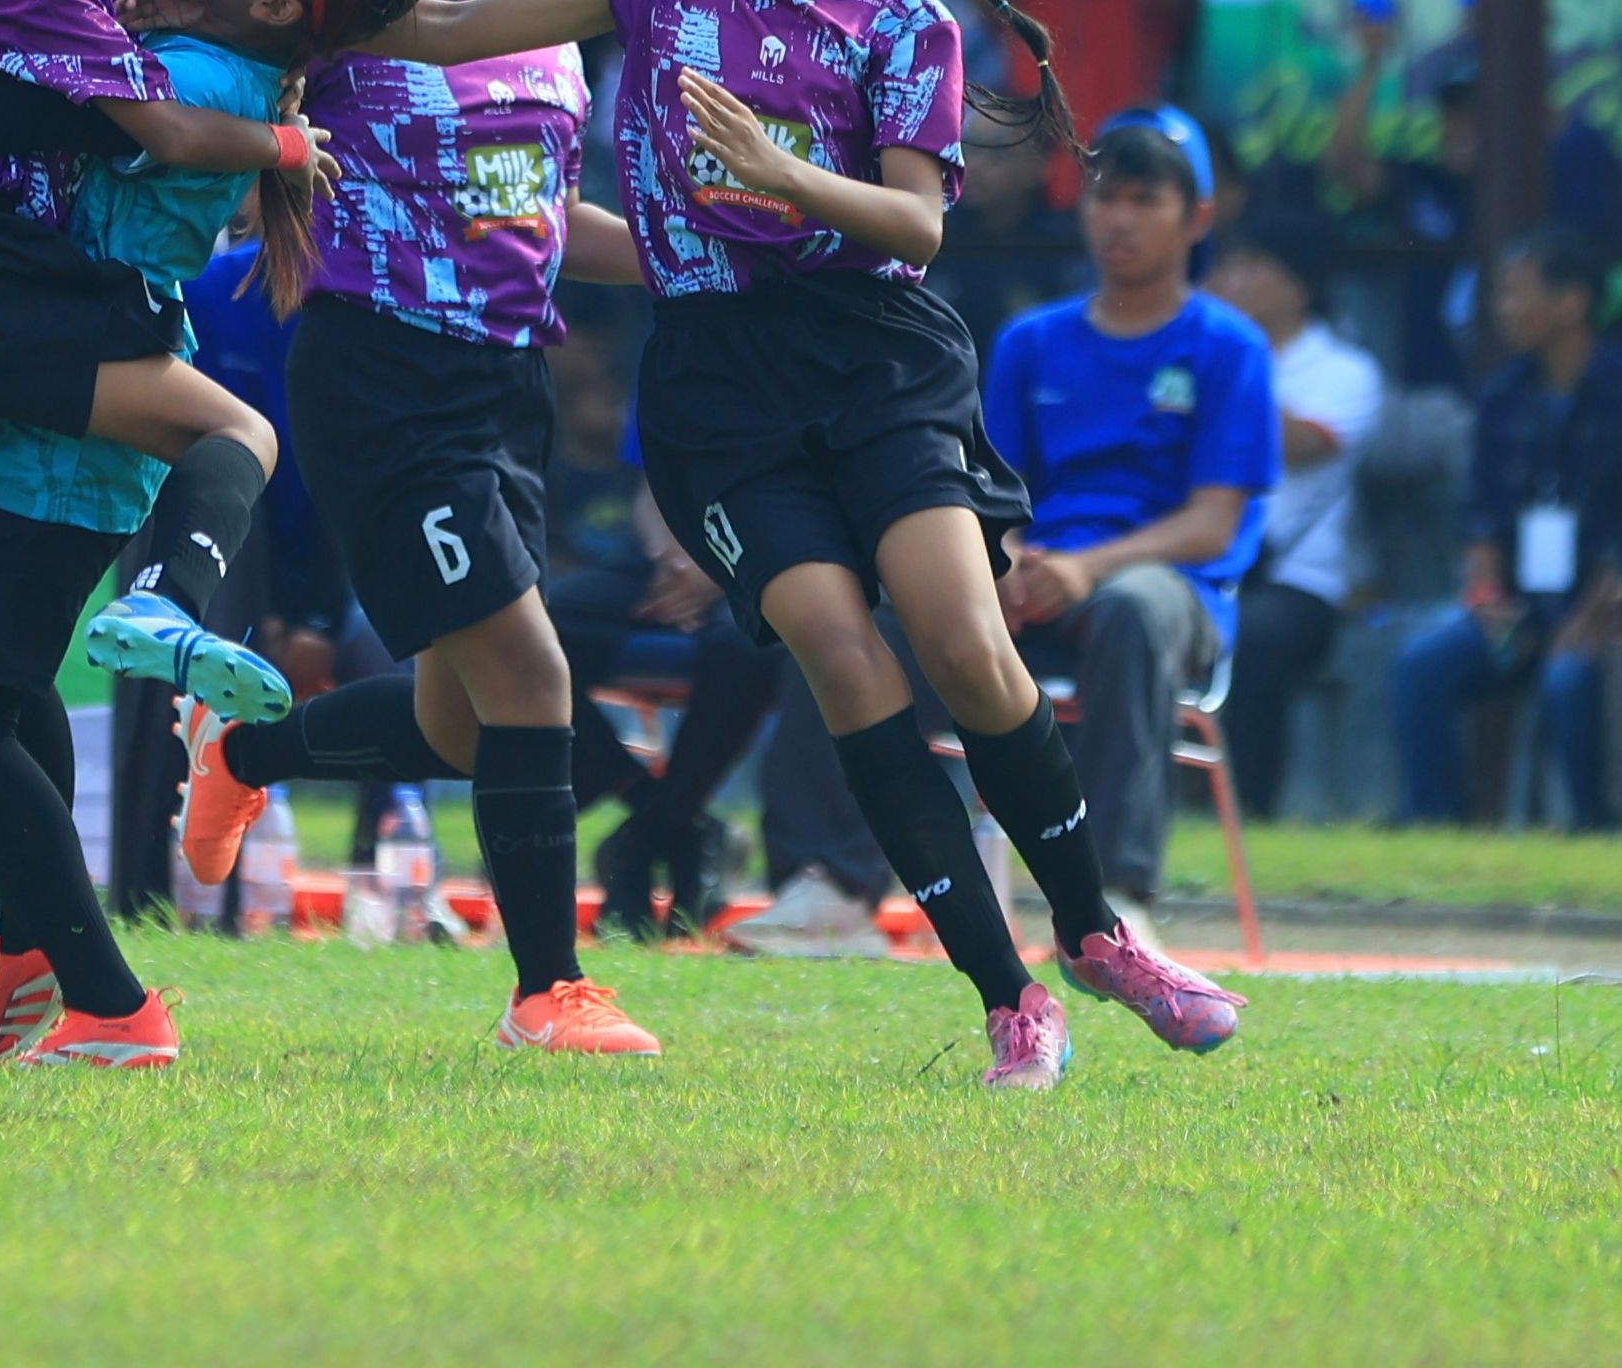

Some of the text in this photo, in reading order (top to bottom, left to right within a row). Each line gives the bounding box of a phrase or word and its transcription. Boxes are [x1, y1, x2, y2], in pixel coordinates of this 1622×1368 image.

[750, 70, 785, 85] MILLS
[475, 150, 540, 185] Milk
[709, 190, 790, 213] SOCCER CHALLENGE
[422, 505, 471, 586] 6
[910, 877, 952, 904] vo
